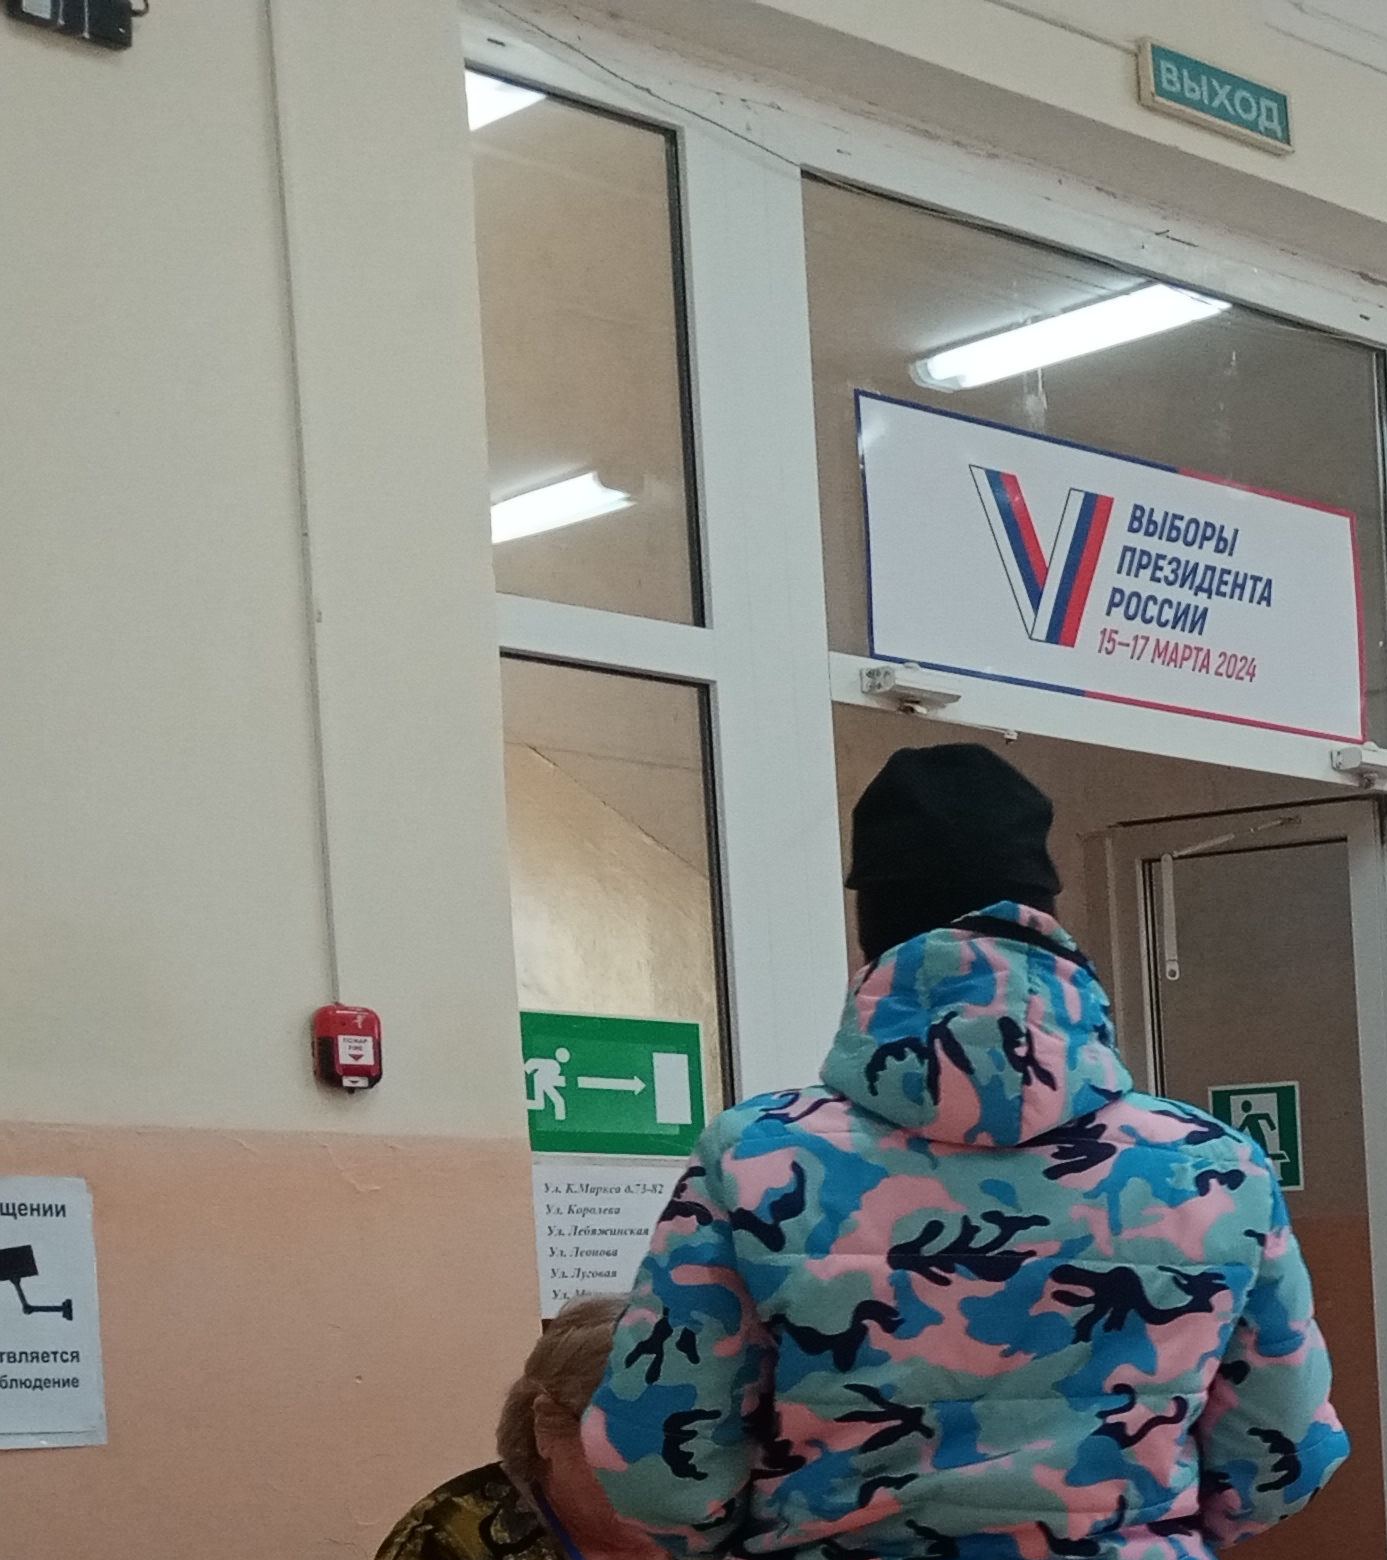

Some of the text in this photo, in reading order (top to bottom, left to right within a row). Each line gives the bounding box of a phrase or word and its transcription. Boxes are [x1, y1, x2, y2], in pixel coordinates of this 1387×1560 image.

[1160, 59, 1282, 139] ВЫХОД
[1127, 503, 1239, 557] ВЫБОРЫ
[1116, 545, 1273, 607] ПРЕЗИДЕНТА
[1105, 586, 1209, 636] РОССИИ
[1150, 637, 1212, 675] МАРТА
[1214, 651, 1257, 683] 2024
[0, 1202, 66, 1220] щении
[568, 1225, 649, 1237] Лебяжинская
[0, 1374, 80, 1391] блюдение
